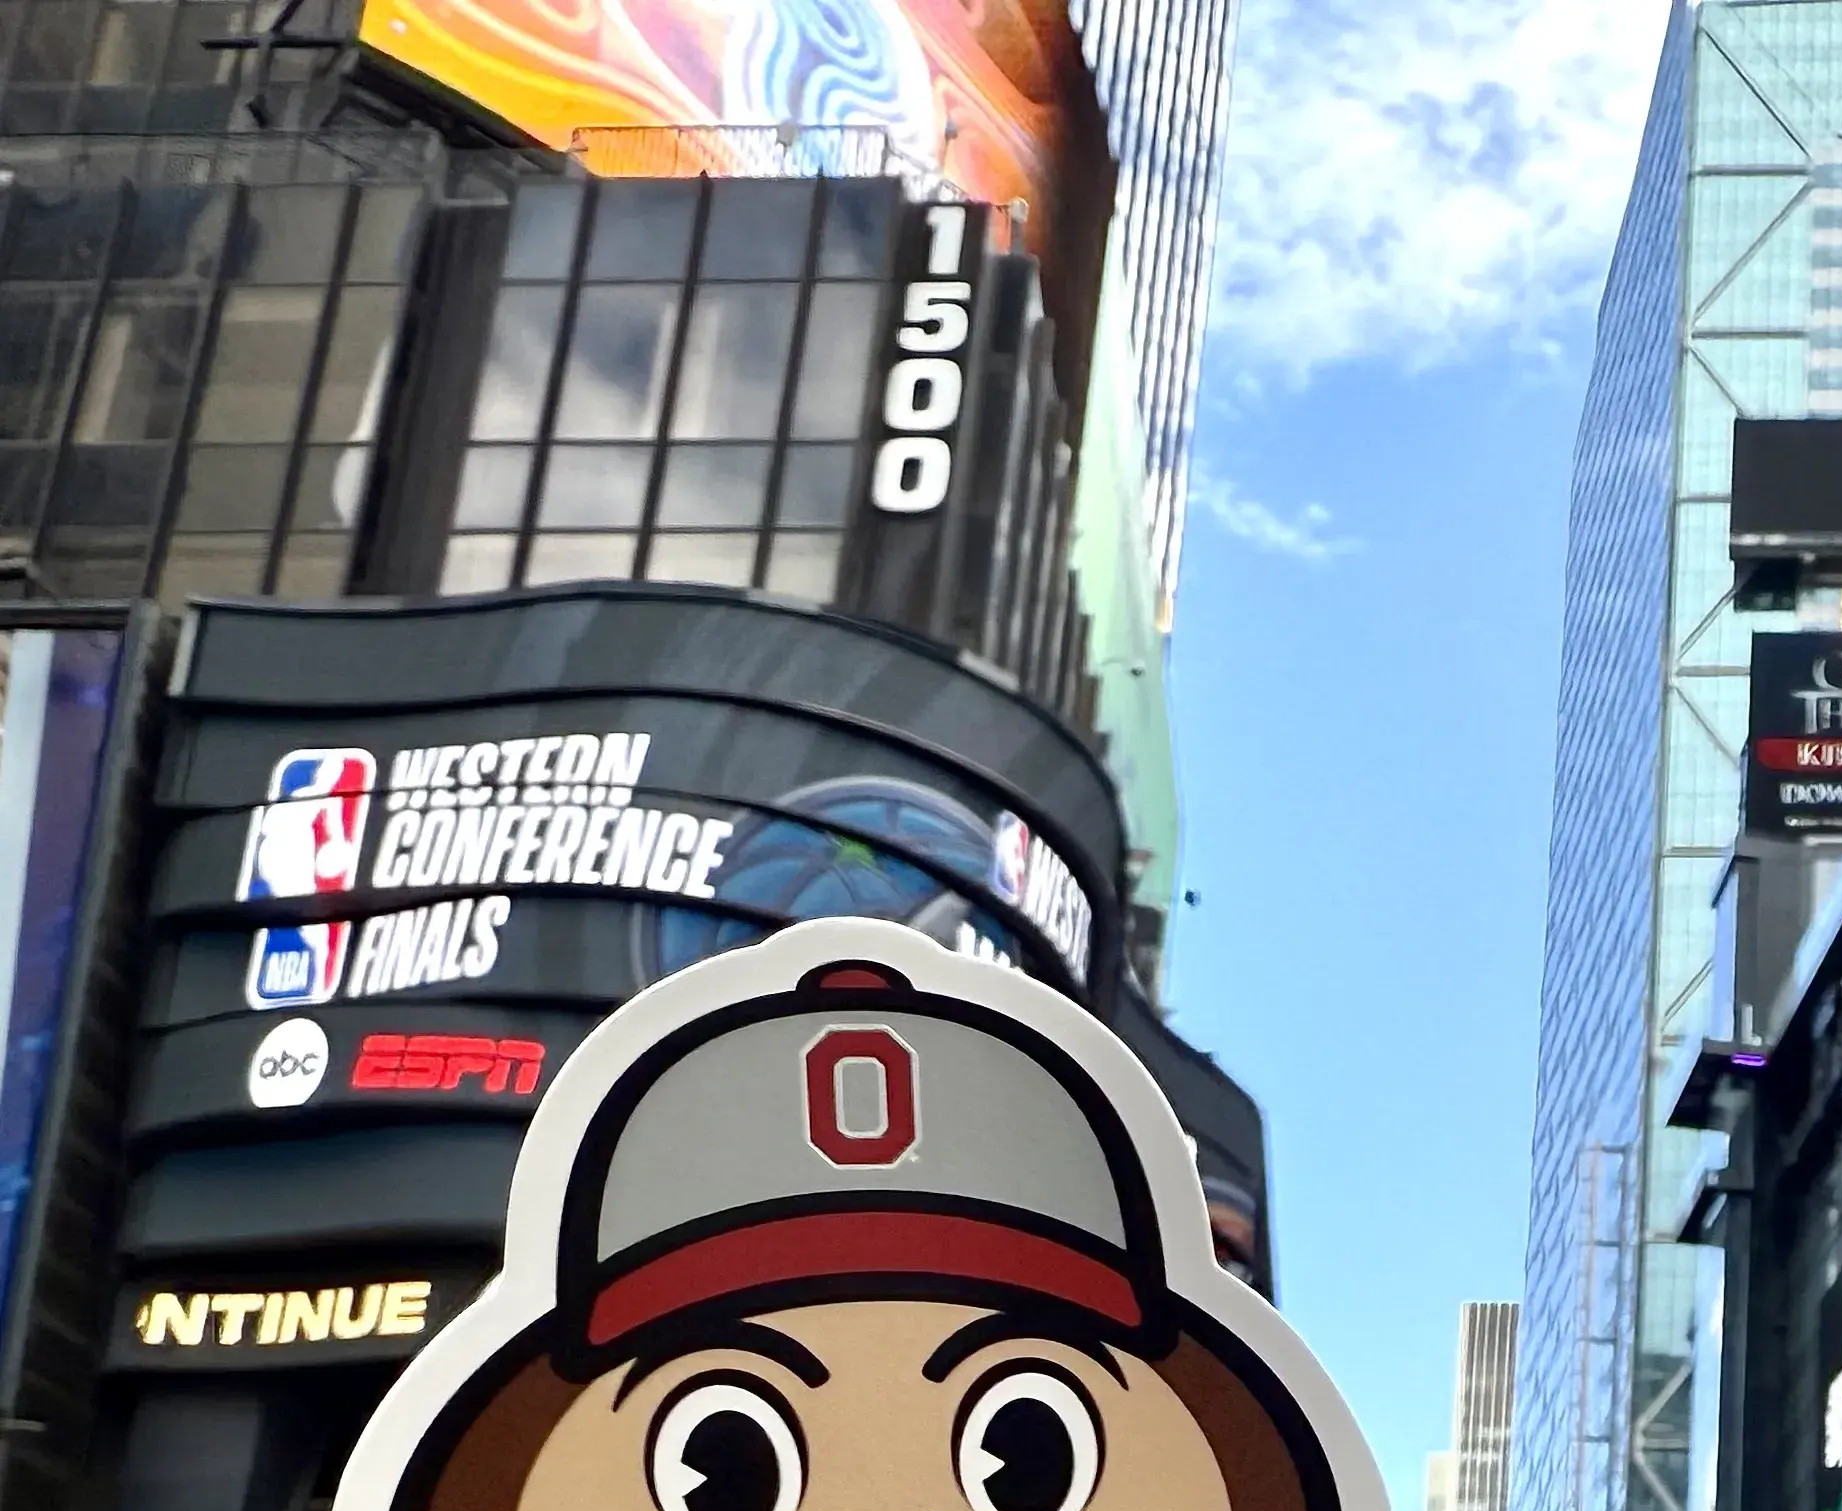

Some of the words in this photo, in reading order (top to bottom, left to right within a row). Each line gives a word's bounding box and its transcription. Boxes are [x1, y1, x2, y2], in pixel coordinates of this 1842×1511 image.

[871, 205, 972, 513] 1500
[387, 733, 651, 810] WESTERN
[372, 803, 734, 899] CONFERENCE
[348, 896, 511, 998] FINALS
[258, 1048, 320, 1082] abc
[352, 1033, 547, 1096] ESPN
